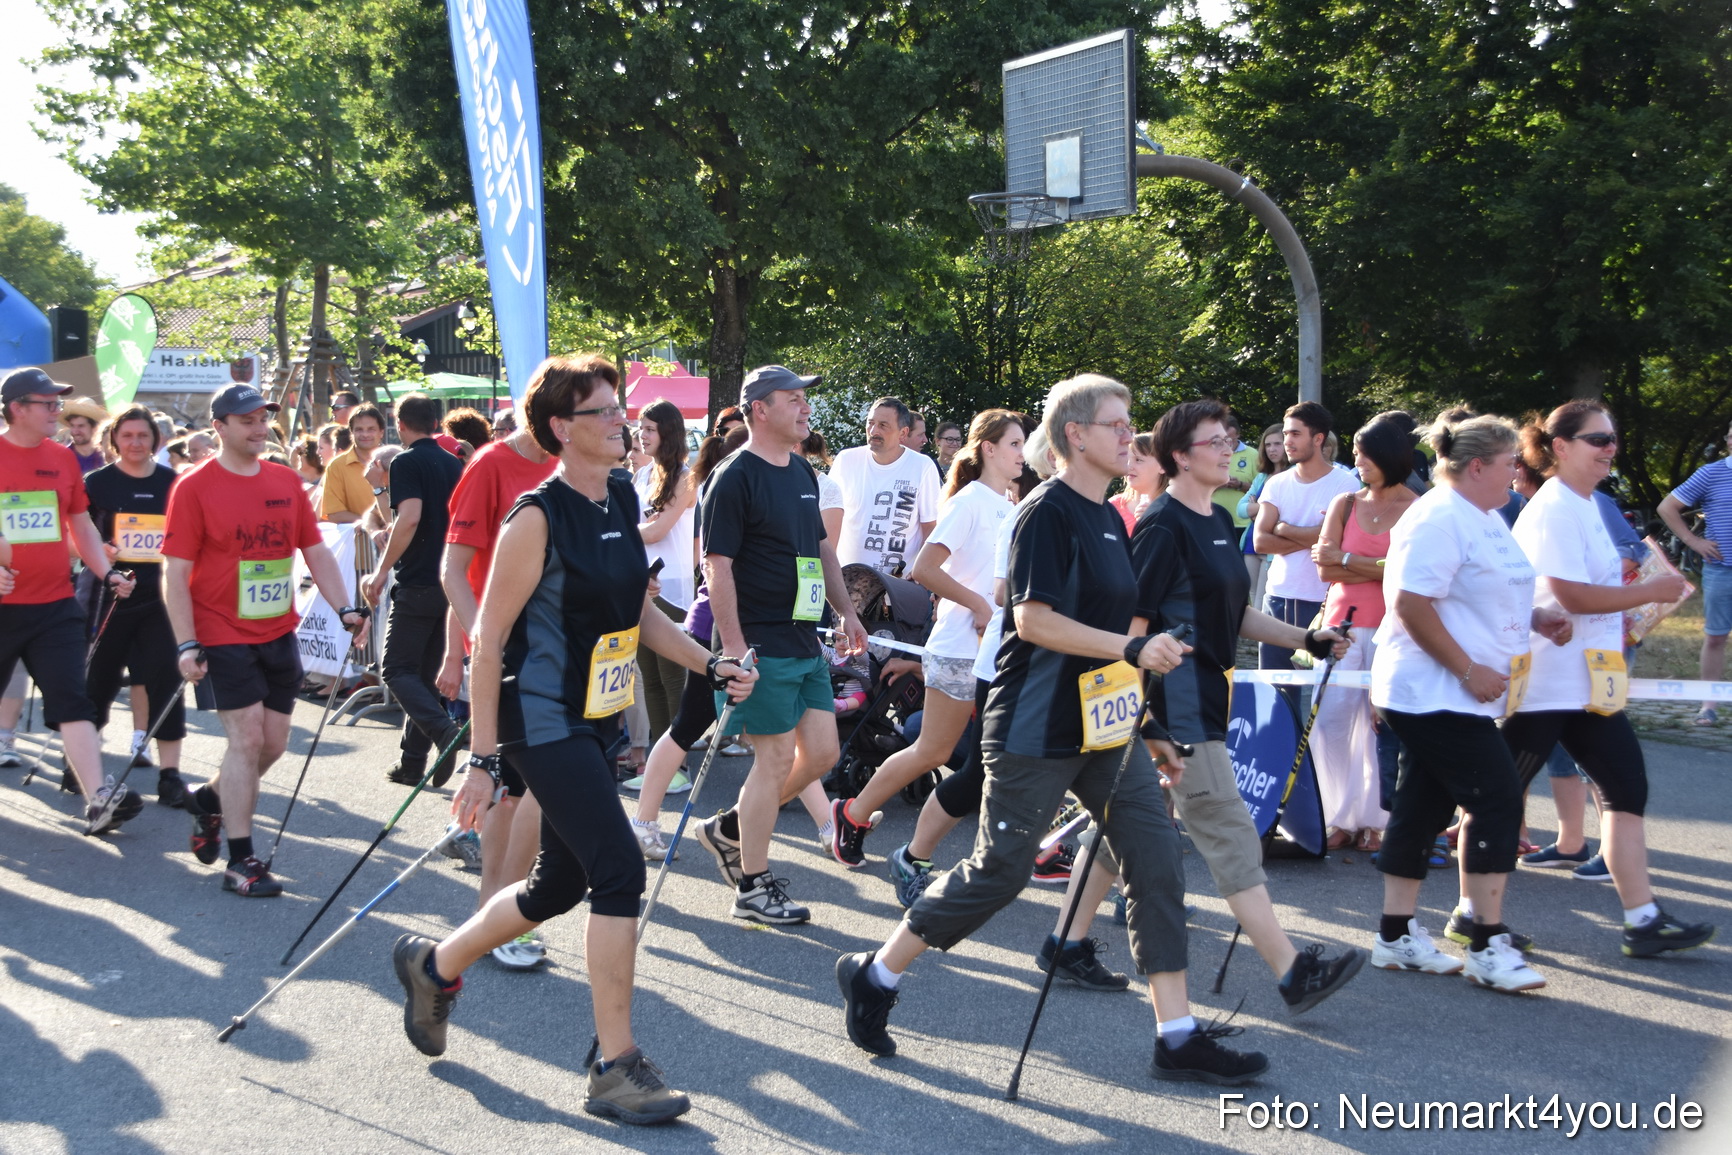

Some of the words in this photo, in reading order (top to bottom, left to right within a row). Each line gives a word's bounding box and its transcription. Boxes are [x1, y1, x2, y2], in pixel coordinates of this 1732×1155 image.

[6, 511, 54, 530] 1522
[884, 490, 918, 570] DENIM
[122, 533, 165, 549] 1202
[247, 581, 290, 603] 1521
[1606, 676, 1615, 698] 3
[1090, 691, 1140, 730] 1203
